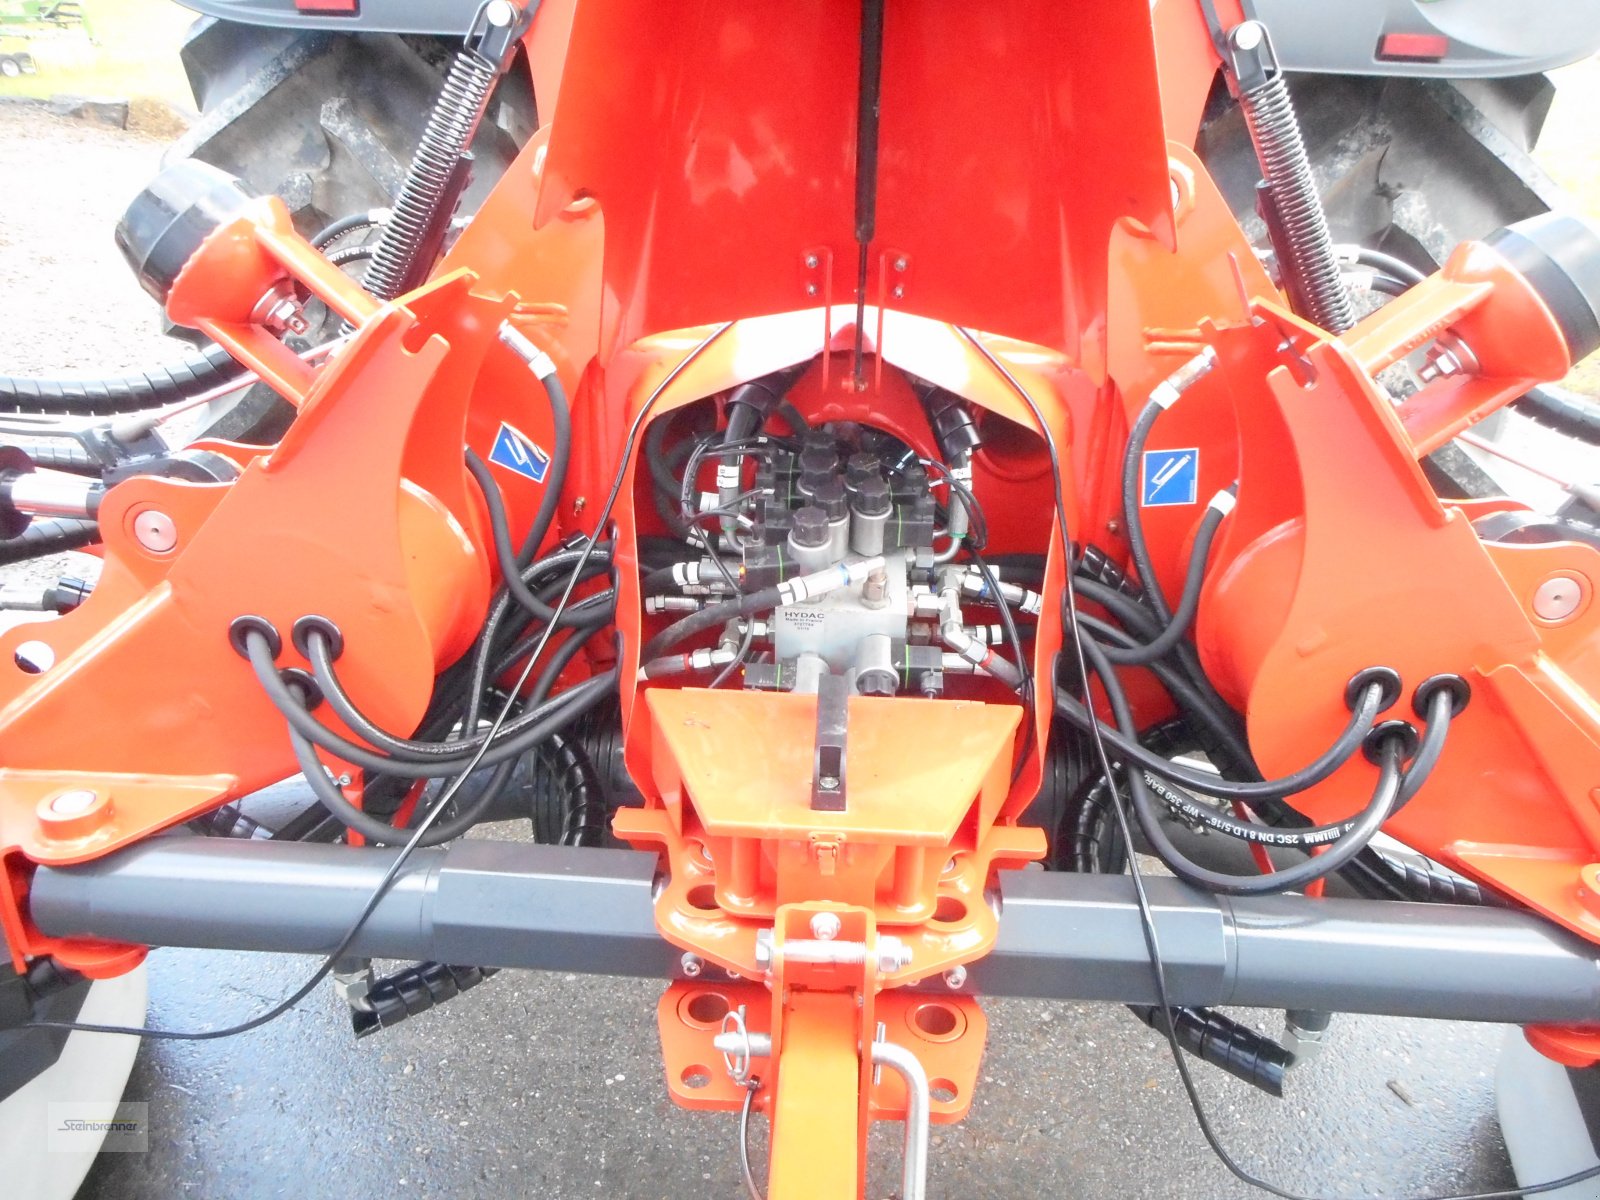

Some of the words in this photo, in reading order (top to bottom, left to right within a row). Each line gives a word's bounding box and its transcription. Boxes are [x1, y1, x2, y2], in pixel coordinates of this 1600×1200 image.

[784, 611, 825, 619] HYDAC
[1165, 791, 1183, 807] 350
[1182, 804, 1199, 818] WP
[1249, 831, 1256, 839] 8
[1258, 832, 1275, 843] DN
[1277, 834, 1300, 844] 2SC
